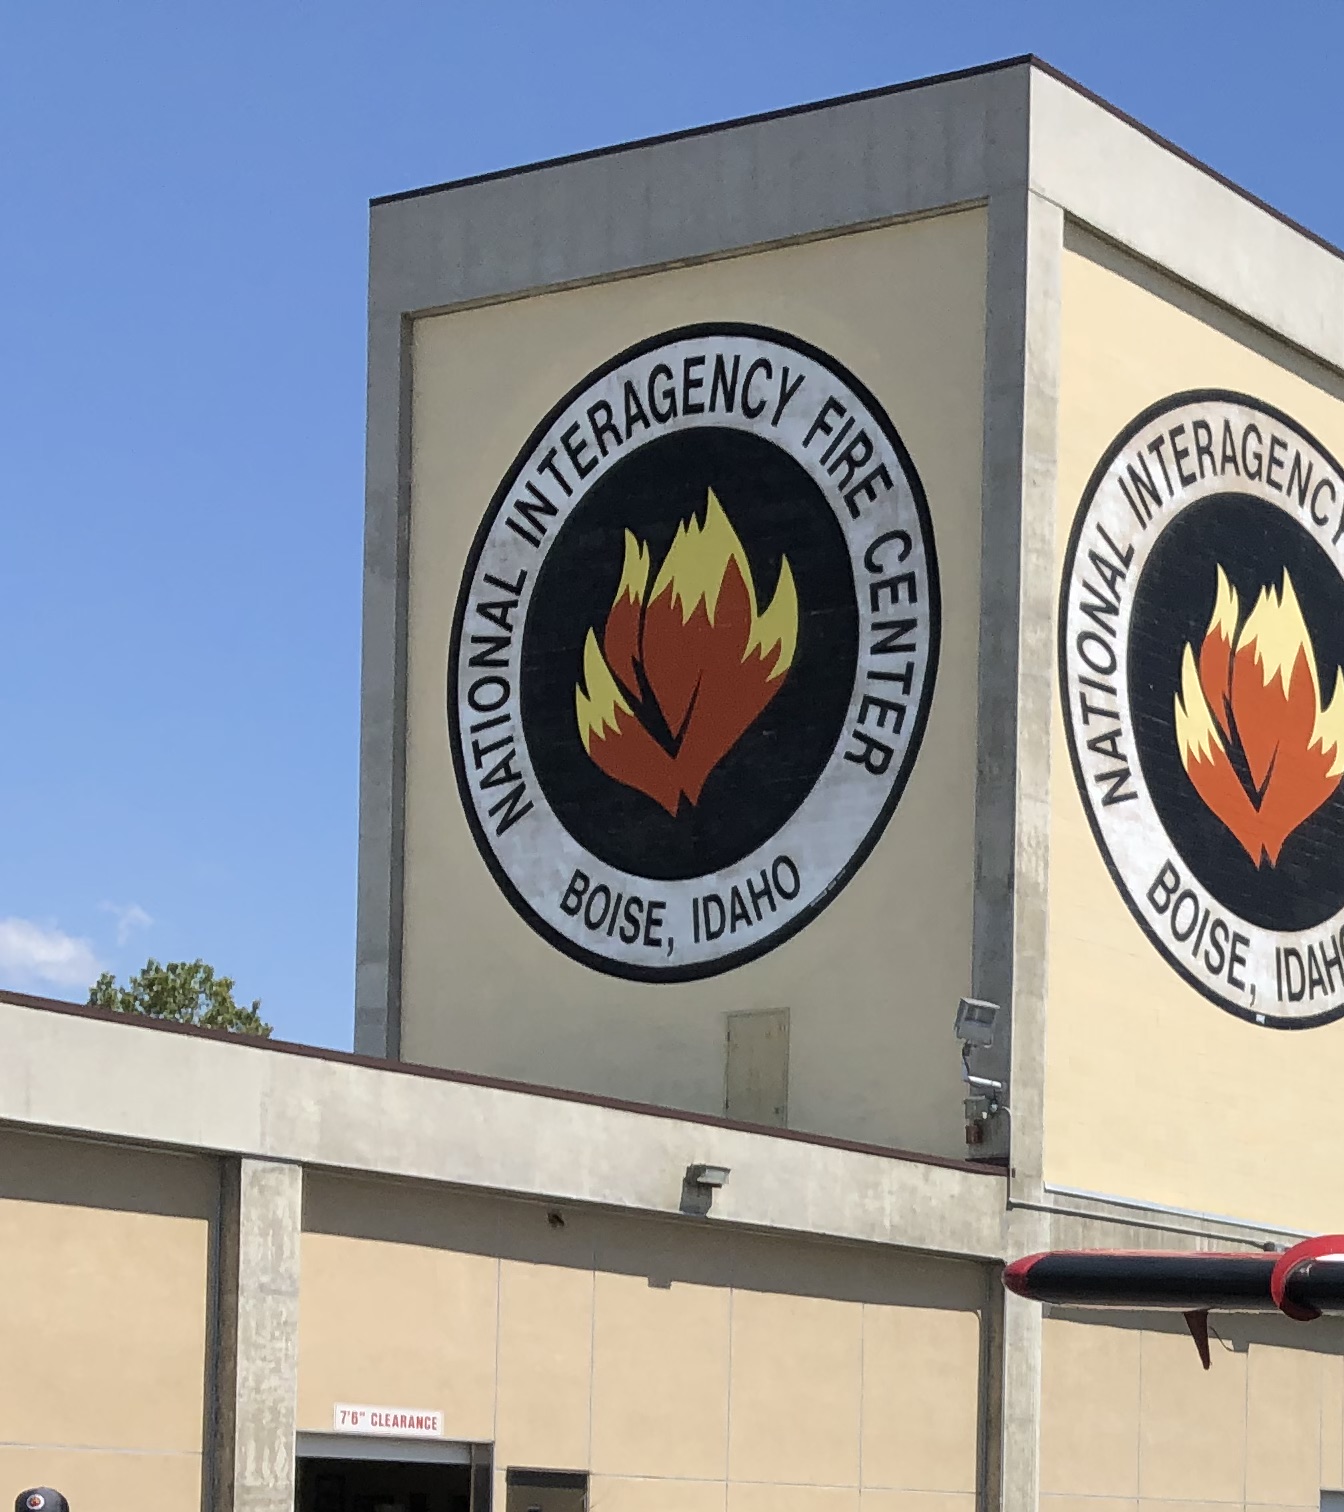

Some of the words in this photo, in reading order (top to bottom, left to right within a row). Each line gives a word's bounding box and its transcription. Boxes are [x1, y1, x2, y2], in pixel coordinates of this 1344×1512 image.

[506, 354, 805, 549] INTERAGENCY
[801, 396, 893, 519] FIRE
[468, 568, 534, 836] NATIONAL
[844, 528, 919, 777] CENTER
[1077, 523, 1139, 807] NATIONAL
[560, 867, 675, 956] BOISE,
[692, 854, 800, 943] IDAHO
[1147, 858, 1257, 1008] BOISE,
[371, 1412, 438, 1431] CLEARANCE
